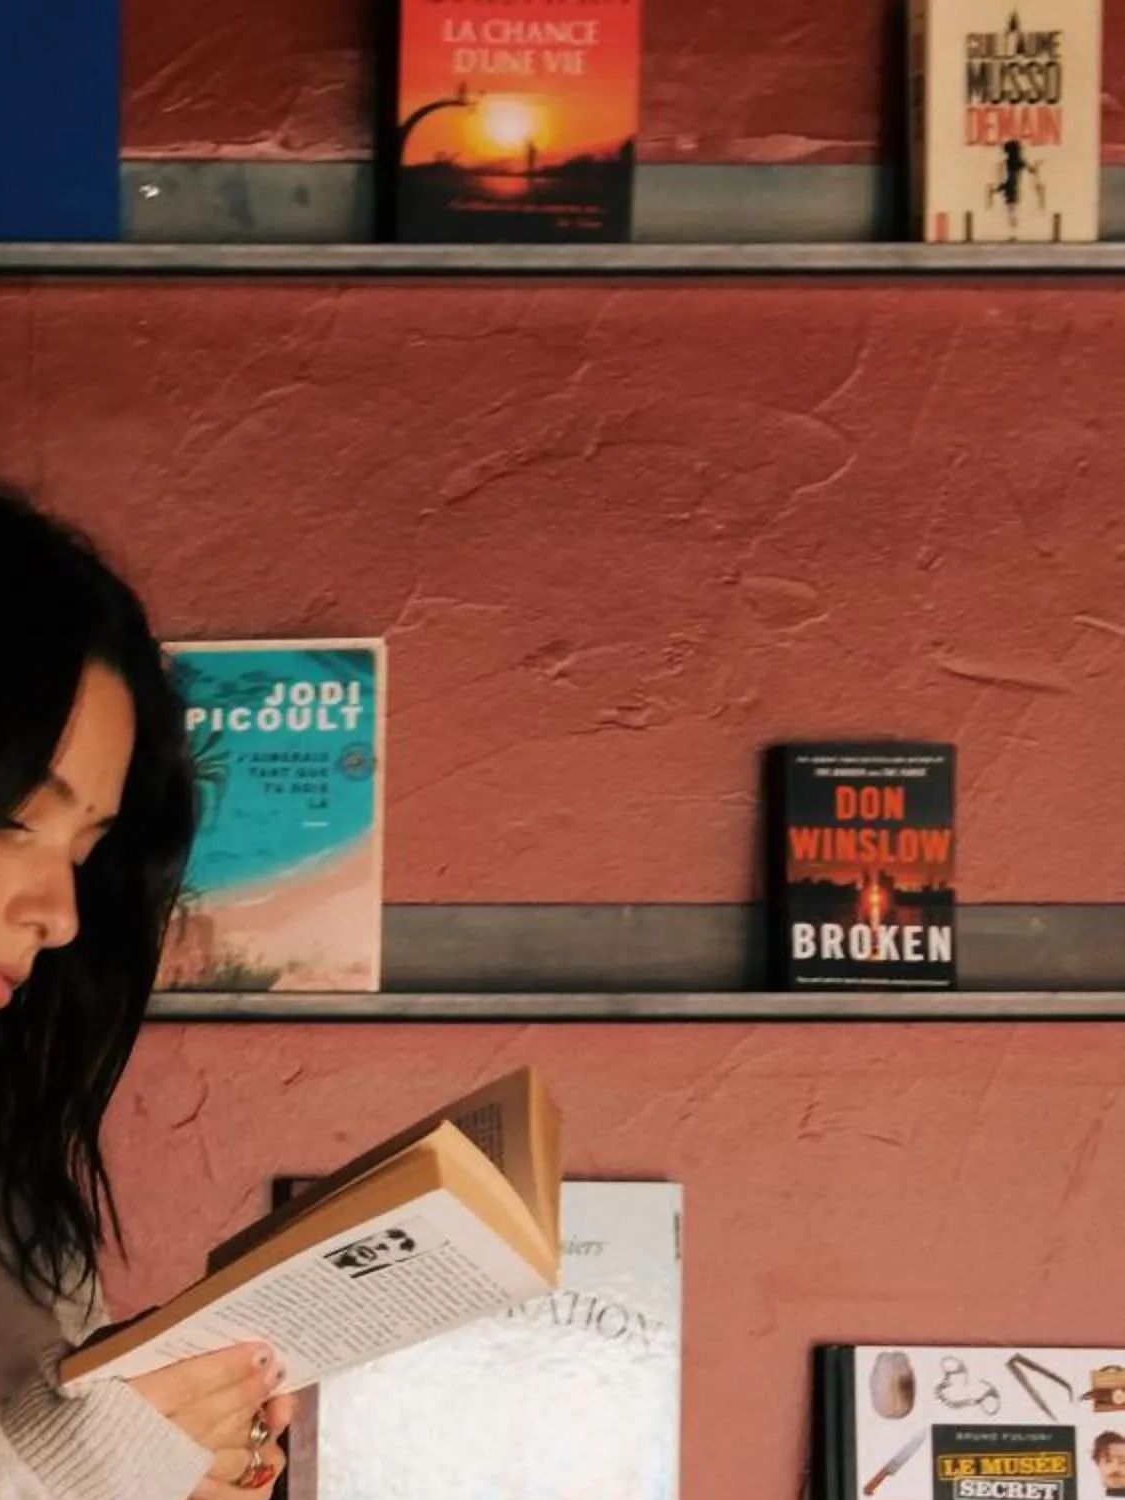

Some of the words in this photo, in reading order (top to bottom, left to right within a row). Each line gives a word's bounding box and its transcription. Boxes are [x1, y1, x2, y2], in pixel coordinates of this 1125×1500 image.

[441, 18, 478, 43] LA
[482, 18, 600, 46] CHANCE
[452, 48, 537, 75] D'UNE
[541, 49, 589, 75] VIE
[965, 61, 1063, 105] MUSSO
[964, 105, 1063, 147] DEMAIN
[263, 681, 362, 707] JODI
[184, 706, 363, 732] PICOULT
[834, 785, 906, 821] DON
[788, 826, 952, 863] WINSLOW
[791, 922, 953, 963] BROKEN
[942, 1457, 975, 1476] LE
[980, 1452, 1067, 1475] MUSÉE
[958, 1478, 1059, 1500] SECRET
